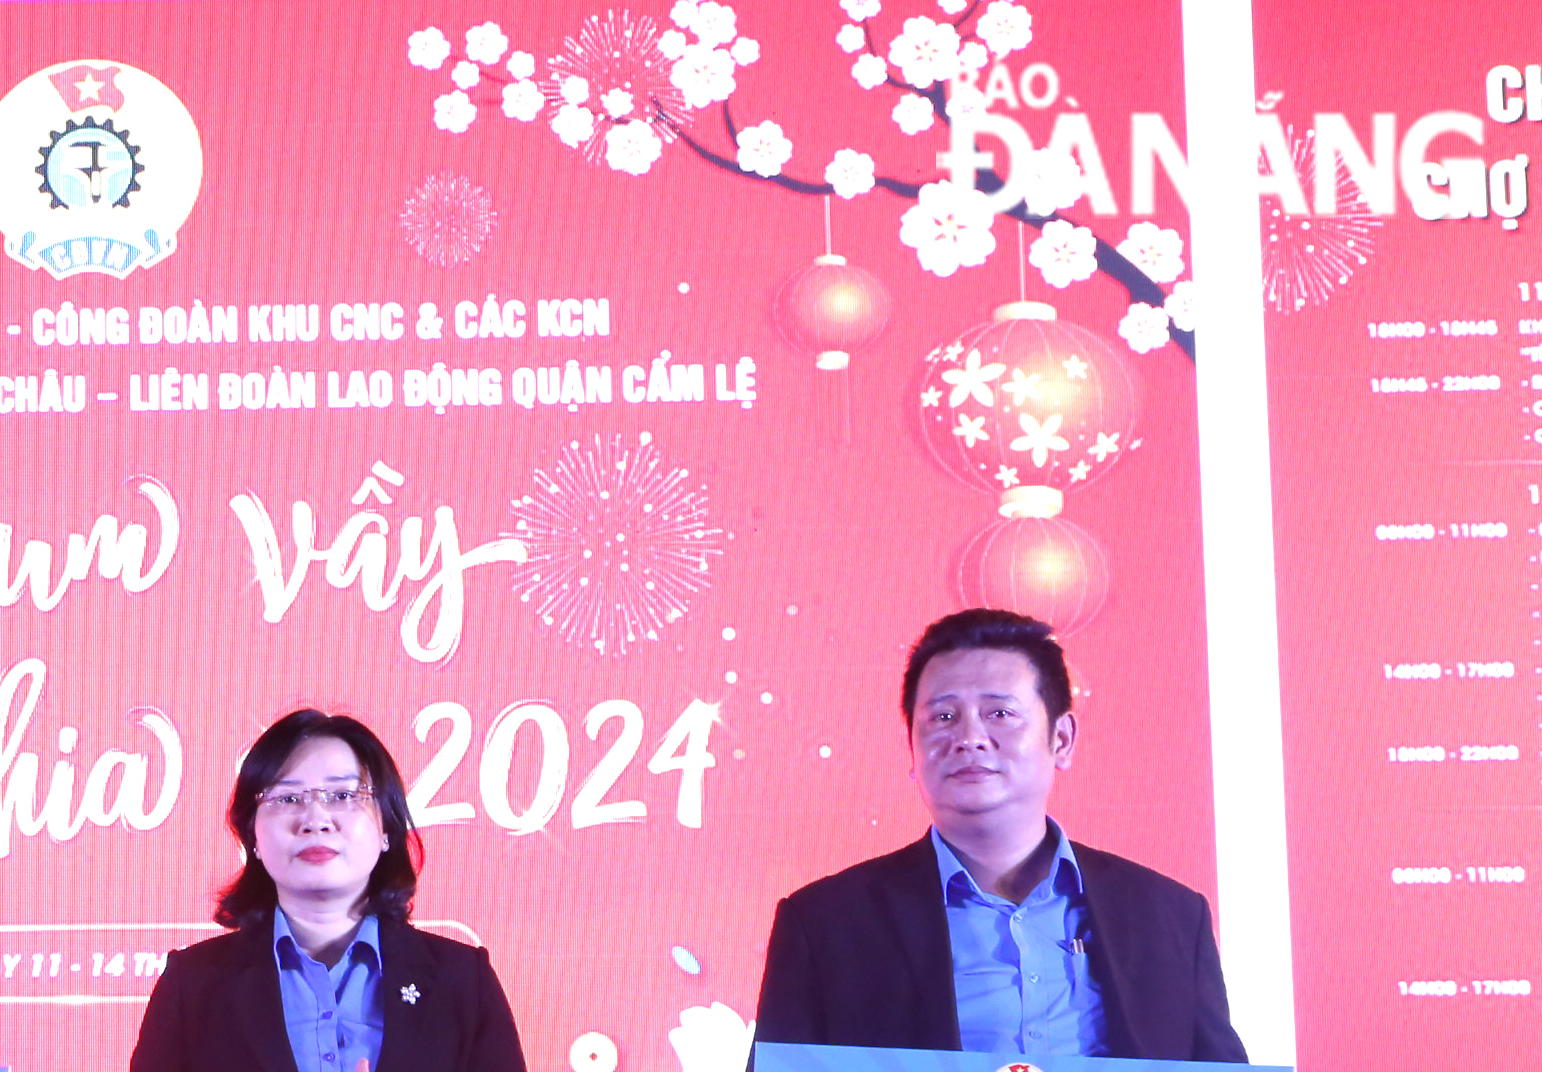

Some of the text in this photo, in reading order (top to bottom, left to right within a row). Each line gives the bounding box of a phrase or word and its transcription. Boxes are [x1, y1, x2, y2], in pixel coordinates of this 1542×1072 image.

[33, 302, 129, 345] CÔNG
[139, 300, 237, 343] ĐOÀN
[249, 305, 318, 341] KHU
[331, 303, 403, 340] CNC
[417, 303, 443, 339] &
[456, 295, 525, 338] CÁC
[538, 299, 609, 336] KCN
[131, 368, 207, 410] LIÊN
[219, 366, 315, 409] ĐOÀN
[328, 371, 392, 407] LAO
[404, 363, 501, 414] ĐỘNG
[513, 360, 611, 411] QUẬN
[717, 357, 756, 408] LỆ
[230, 460, 527, 666] vầy
[405, 697, 723, 835] 2024
[32, 953, 60, 978] 11
[93, 953, 125, 977] 14
